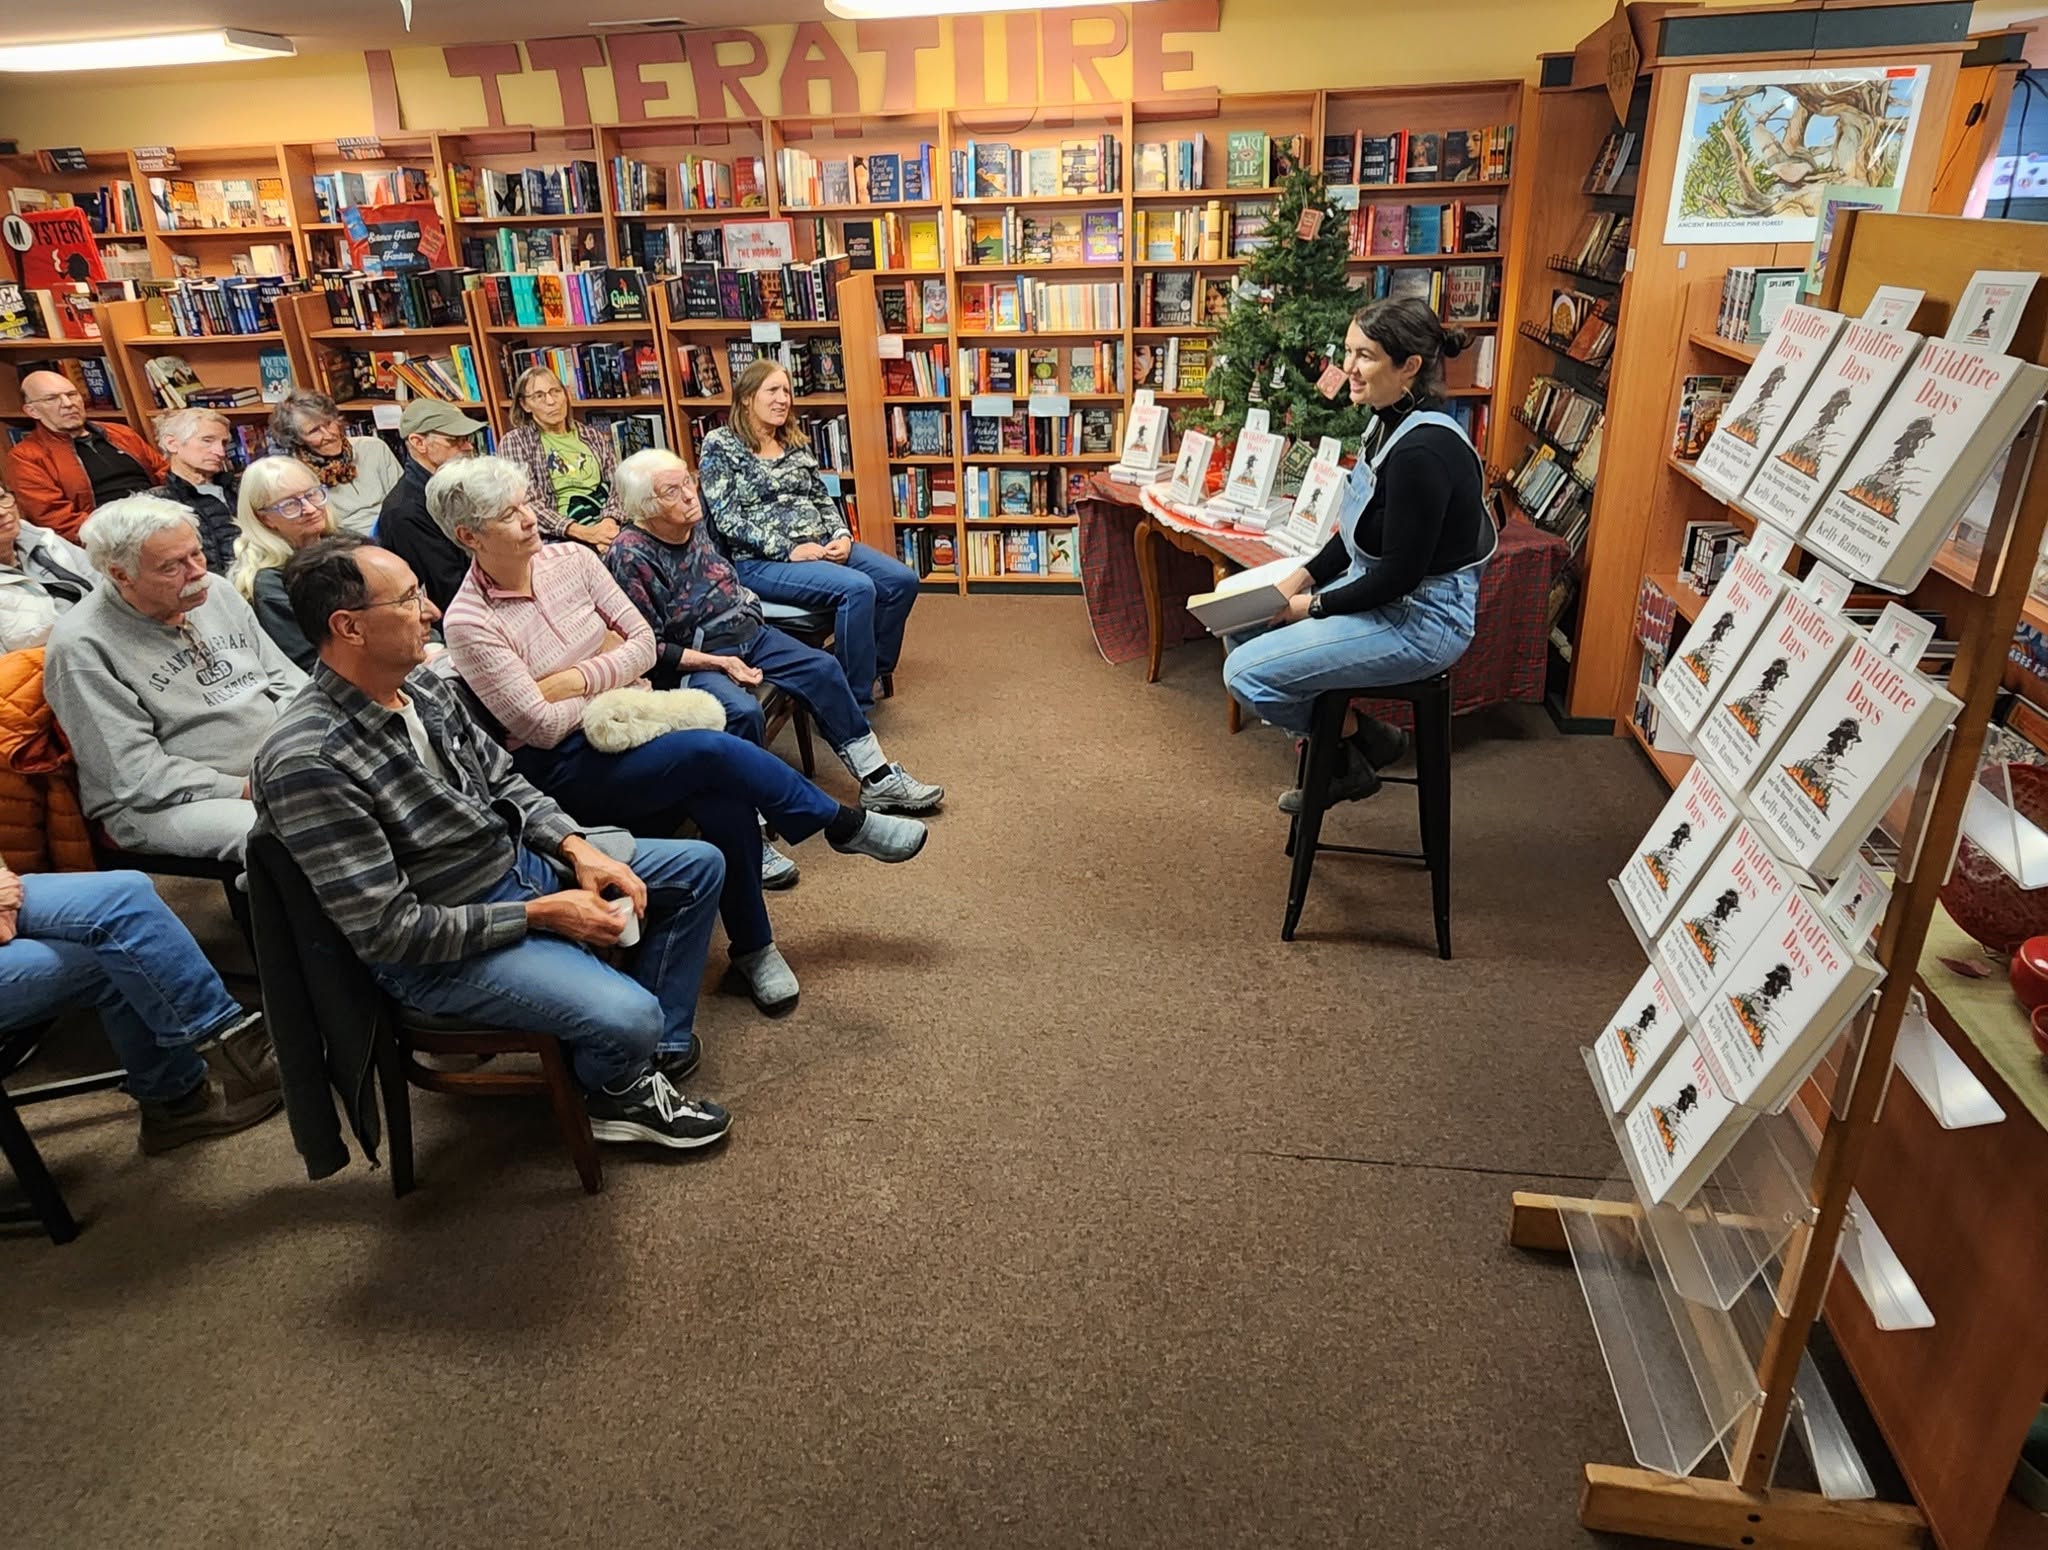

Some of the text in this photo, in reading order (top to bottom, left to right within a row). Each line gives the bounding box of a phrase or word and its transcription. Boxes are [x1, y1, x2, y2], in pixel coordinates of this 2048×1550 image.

[364, 4, 1222, 153] LITERATURE
[1239, 136, 1263, 151] ART
[1235, 160, 1259, 177] LIE
[8, 217, 88, 246] MYSTERY
[394, 228, 420, 241] Fiction
[382, 250, 415, 263] Fantasy
[610, 289, 640, 309] Elphie
[1450, 292, 1478, 305] GONE
[1463, 281, 1482, 293] FAR
[1780, 306, 1830, 341] Wildfire
[1775, 334, 1804, 363] Days
[1844, 324, 1904, 362] Wildfire
[260, 356, 289, 369] ANCIENT
[265, 367, 285, 379] ONES
[1839, 354, 1874, 386] Days
[1917, 344, 2001, 391] Wildfire
[1914, 378, 1963, 416] Days
[1816, 520, 1838, 546] Kelly
[1837, 533, 1872, 568] Ramsey
[1731, 554, 1773, 601] Wildfire
[1726, 582, 1752, 616] Days
[1783, 595, 1835, 650] Wildfire
[1778, 624, 1810, 663] Days
[197, 662, 231, 685] UCSB
[1850, 645, 1917, 715] Wildfire
[1846, 679, 1885, 727] Days
[1685, 793, 1709, 830] Days
[1688, 766, 1727, 823] Wildfire
[1760, 790, 1806, 852] Kelly Ramsey
[1731, 857, 1760, 901] Days
[1735, 827, 1782, 897] Wildfire
[1780, 928, 1813, 979] Days
[1786, 893, 1841, 976] Wildfire
[1692, 1055, 1715, 1099] Days
